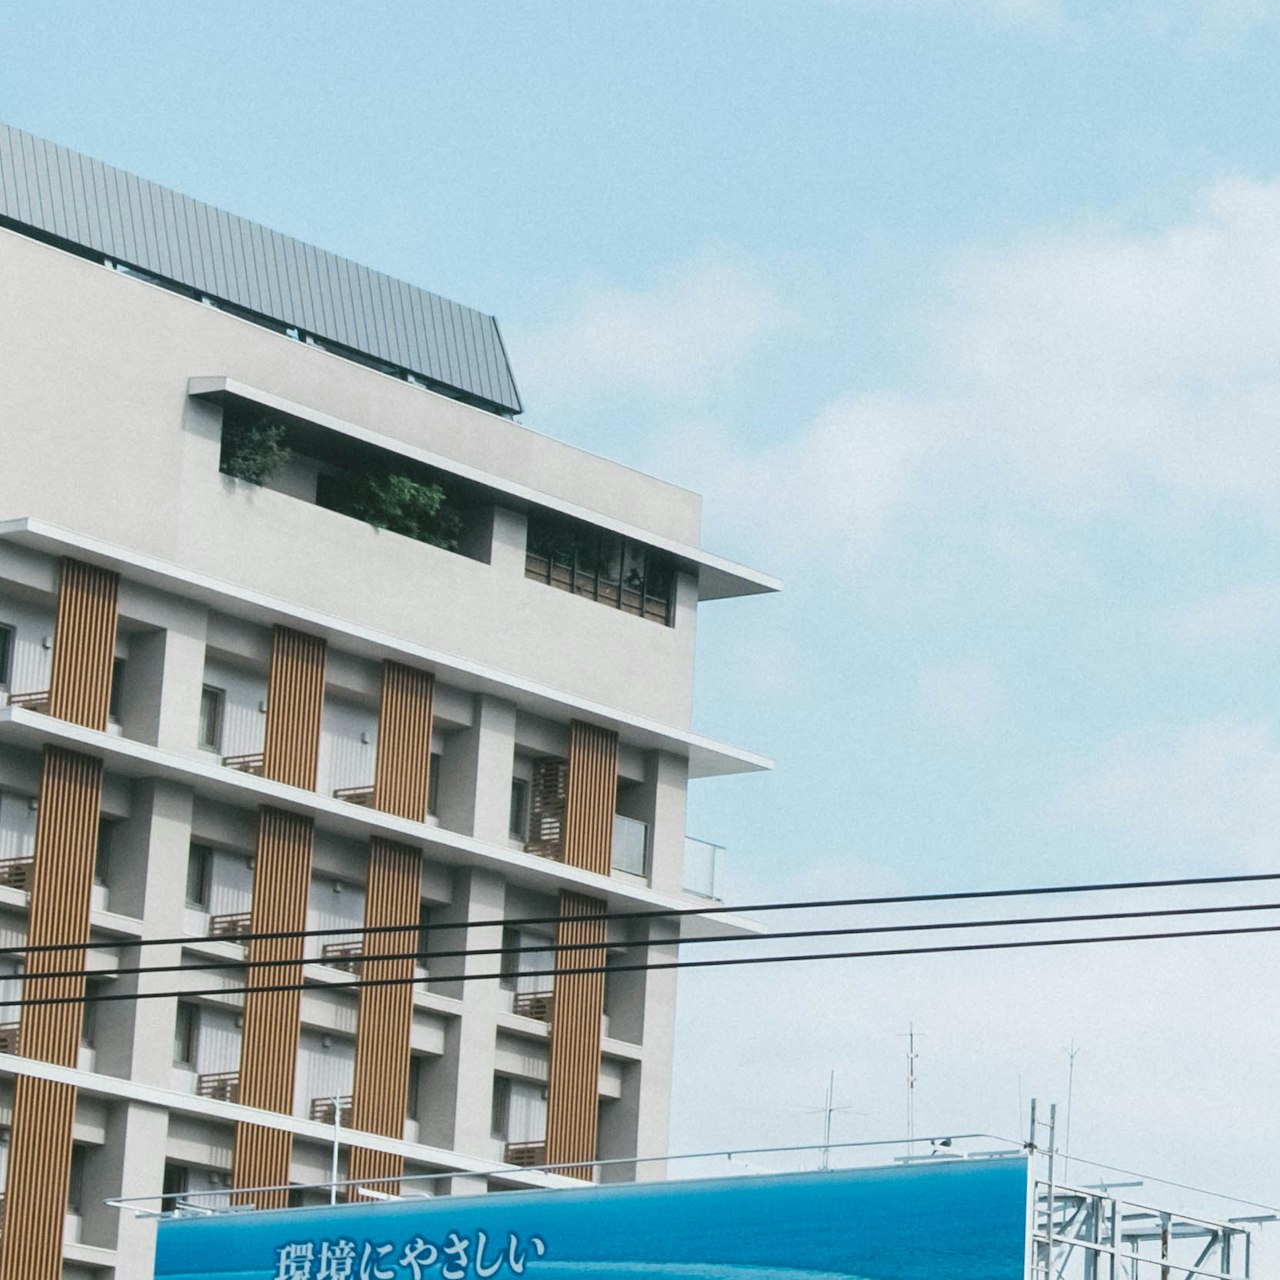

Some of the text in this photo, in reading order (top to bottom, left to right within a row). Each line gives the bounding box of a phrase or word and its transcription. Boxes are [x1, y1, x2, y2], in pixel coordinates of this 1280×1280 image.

[273, 1231, 546, 1280] 環境にやさしい
